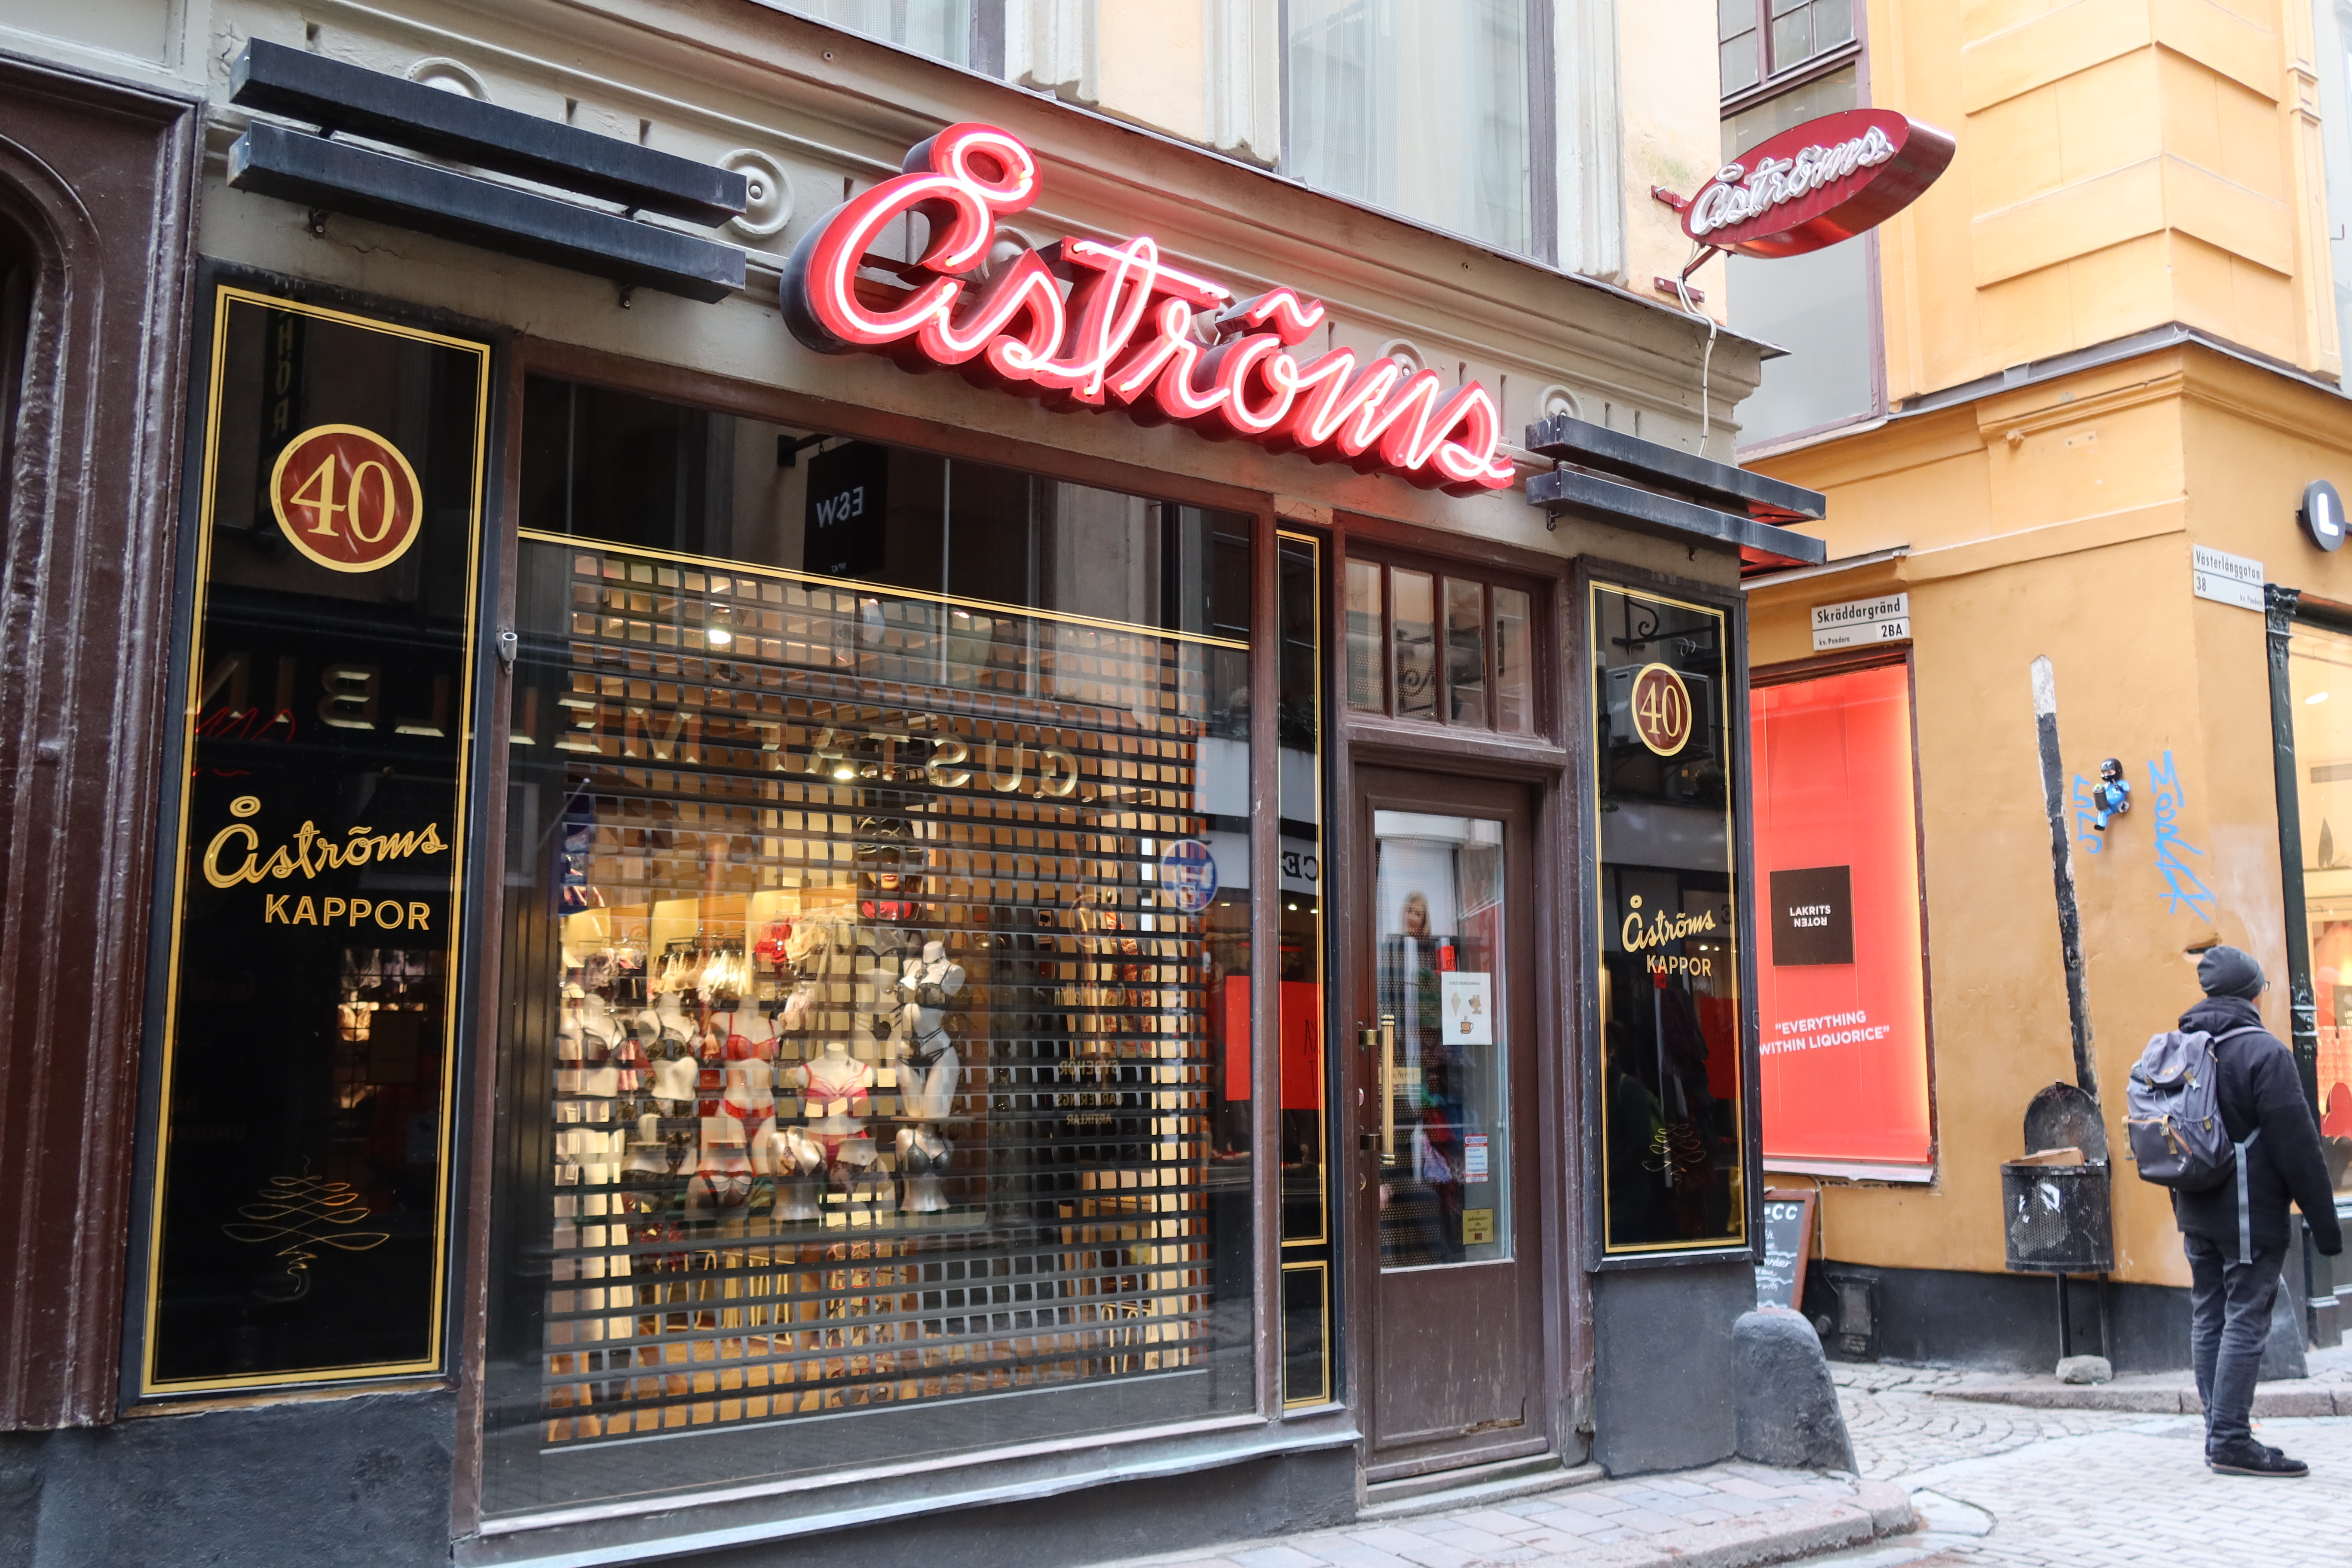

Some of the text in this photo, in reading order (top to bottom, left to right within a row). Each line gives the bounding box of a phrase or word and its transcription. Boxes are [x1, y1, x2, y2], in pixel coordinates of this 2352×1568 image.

[289, 453, 395, 543] 40
[2318, 493, 2339, 536] L
[2196, 550, 2260, 580] Västerlånggatan
[2196, 576, 2207, 591] 38
[1817, 597, 1900, 623] Skräddargränd
[1828, 636, 1850, 645] Pandora
[1881, 623, 1902, 638] 2BA
[1640, 682, 1681, 738] 40
[264, 893, 430, 931] KAPPOR
[1789, 905, 1831, 917] LAKRITS
[1794, 916, 1828, 928] ROTEN
[1647, 955, 1712, 977] KAPPOR
[1759, 1038, 1806, 1056] WITHIN
